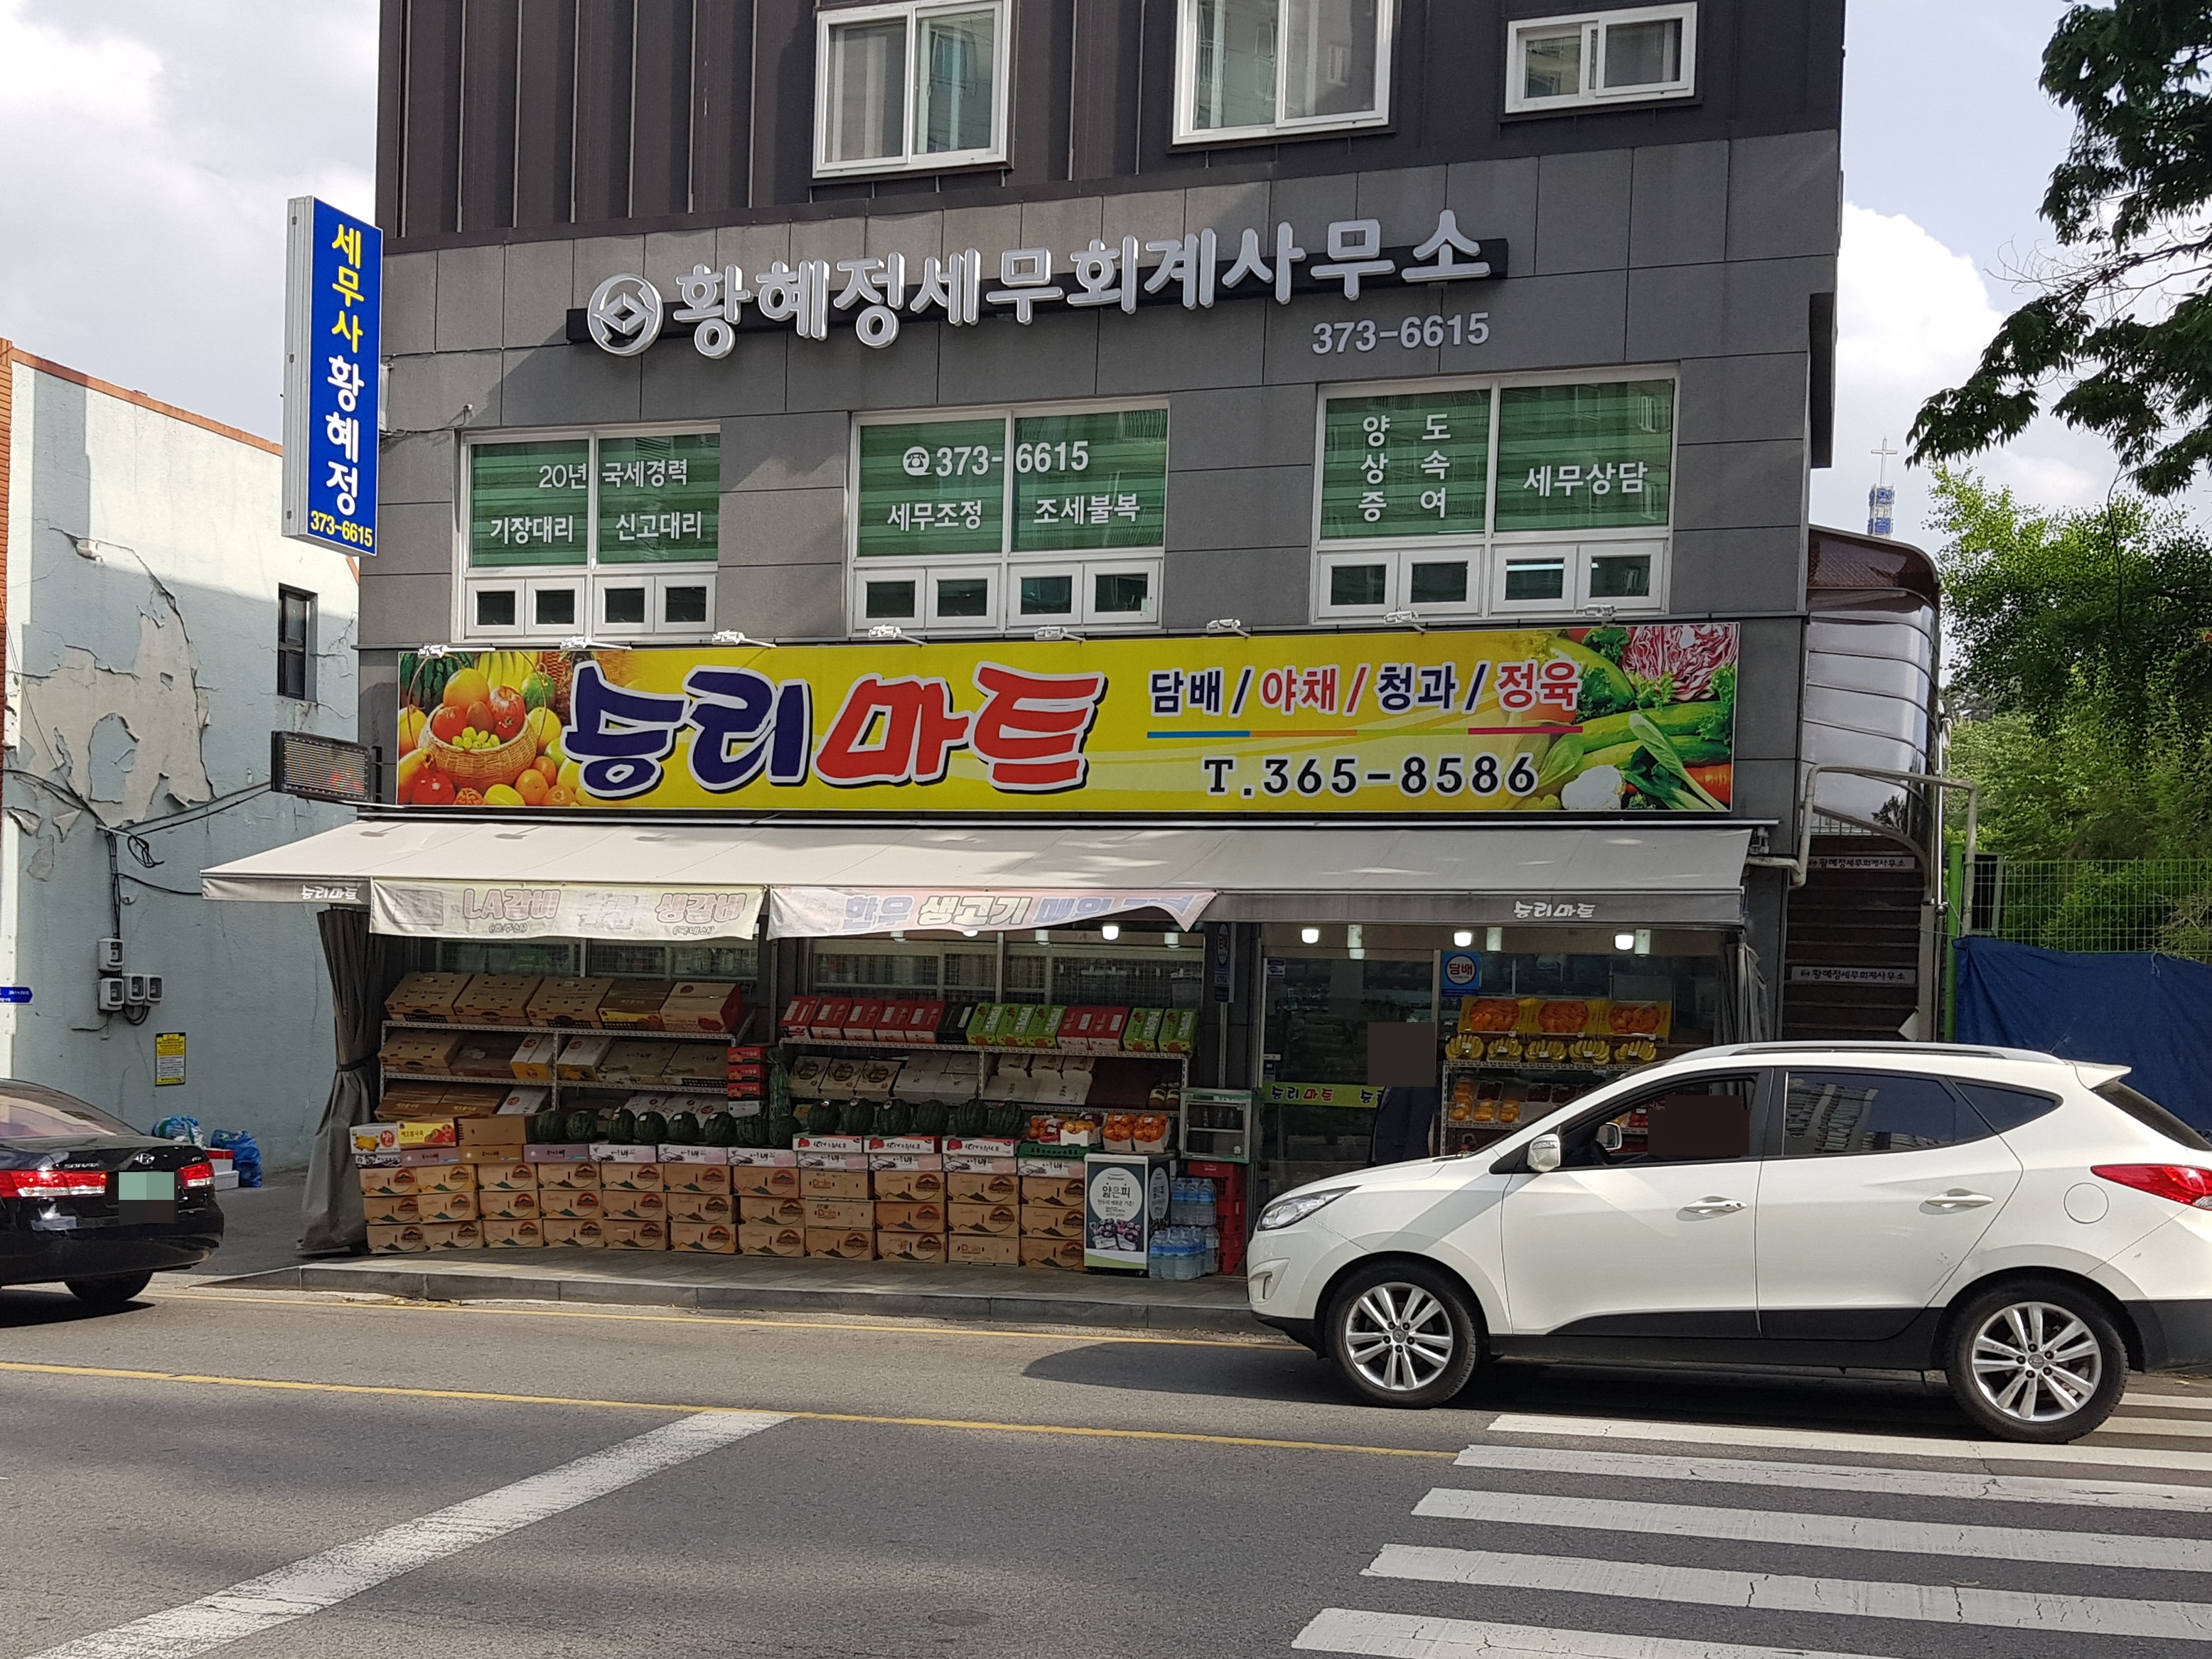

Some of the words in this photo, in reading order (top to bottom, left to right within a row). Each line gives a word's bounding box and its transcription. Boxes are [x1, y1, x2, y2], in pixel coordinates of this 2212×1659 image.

[1311, 310, 1491, 355] 373-6615
[538, 463, 588, 491] 20년
[601, 458, 689, 489] 국세경력
[1523, 461, 1649, 496] 세무상담
[616, 510, 703, 542] 신고대리
[886, 500, 984, 532] 세무조정
[1033, 493, 1141, 526] 조세불복
[310, 509, 374, 549] 373-6615
[490, 515, 574, 546] 기장대리
[561, 659, 1107, 798] 승리마트
[1205, 753, 1540, 798] T.365-8586
[301, 884, 358, 900] 승리마트
[463, 888, 561, 921] LA갈비
[655, 893, 746, 923] 생갈비
[842, 894, 915, 930] 한우
[918, 896, 1032, 927] 생고기
[1513, 900, 1596, 919] 승리마트
[1449, 962, 1473, 976] 담배
[1271, 1085, 1333, 1102] 승리마트
[812, 1179, 832, 1189] Dole
